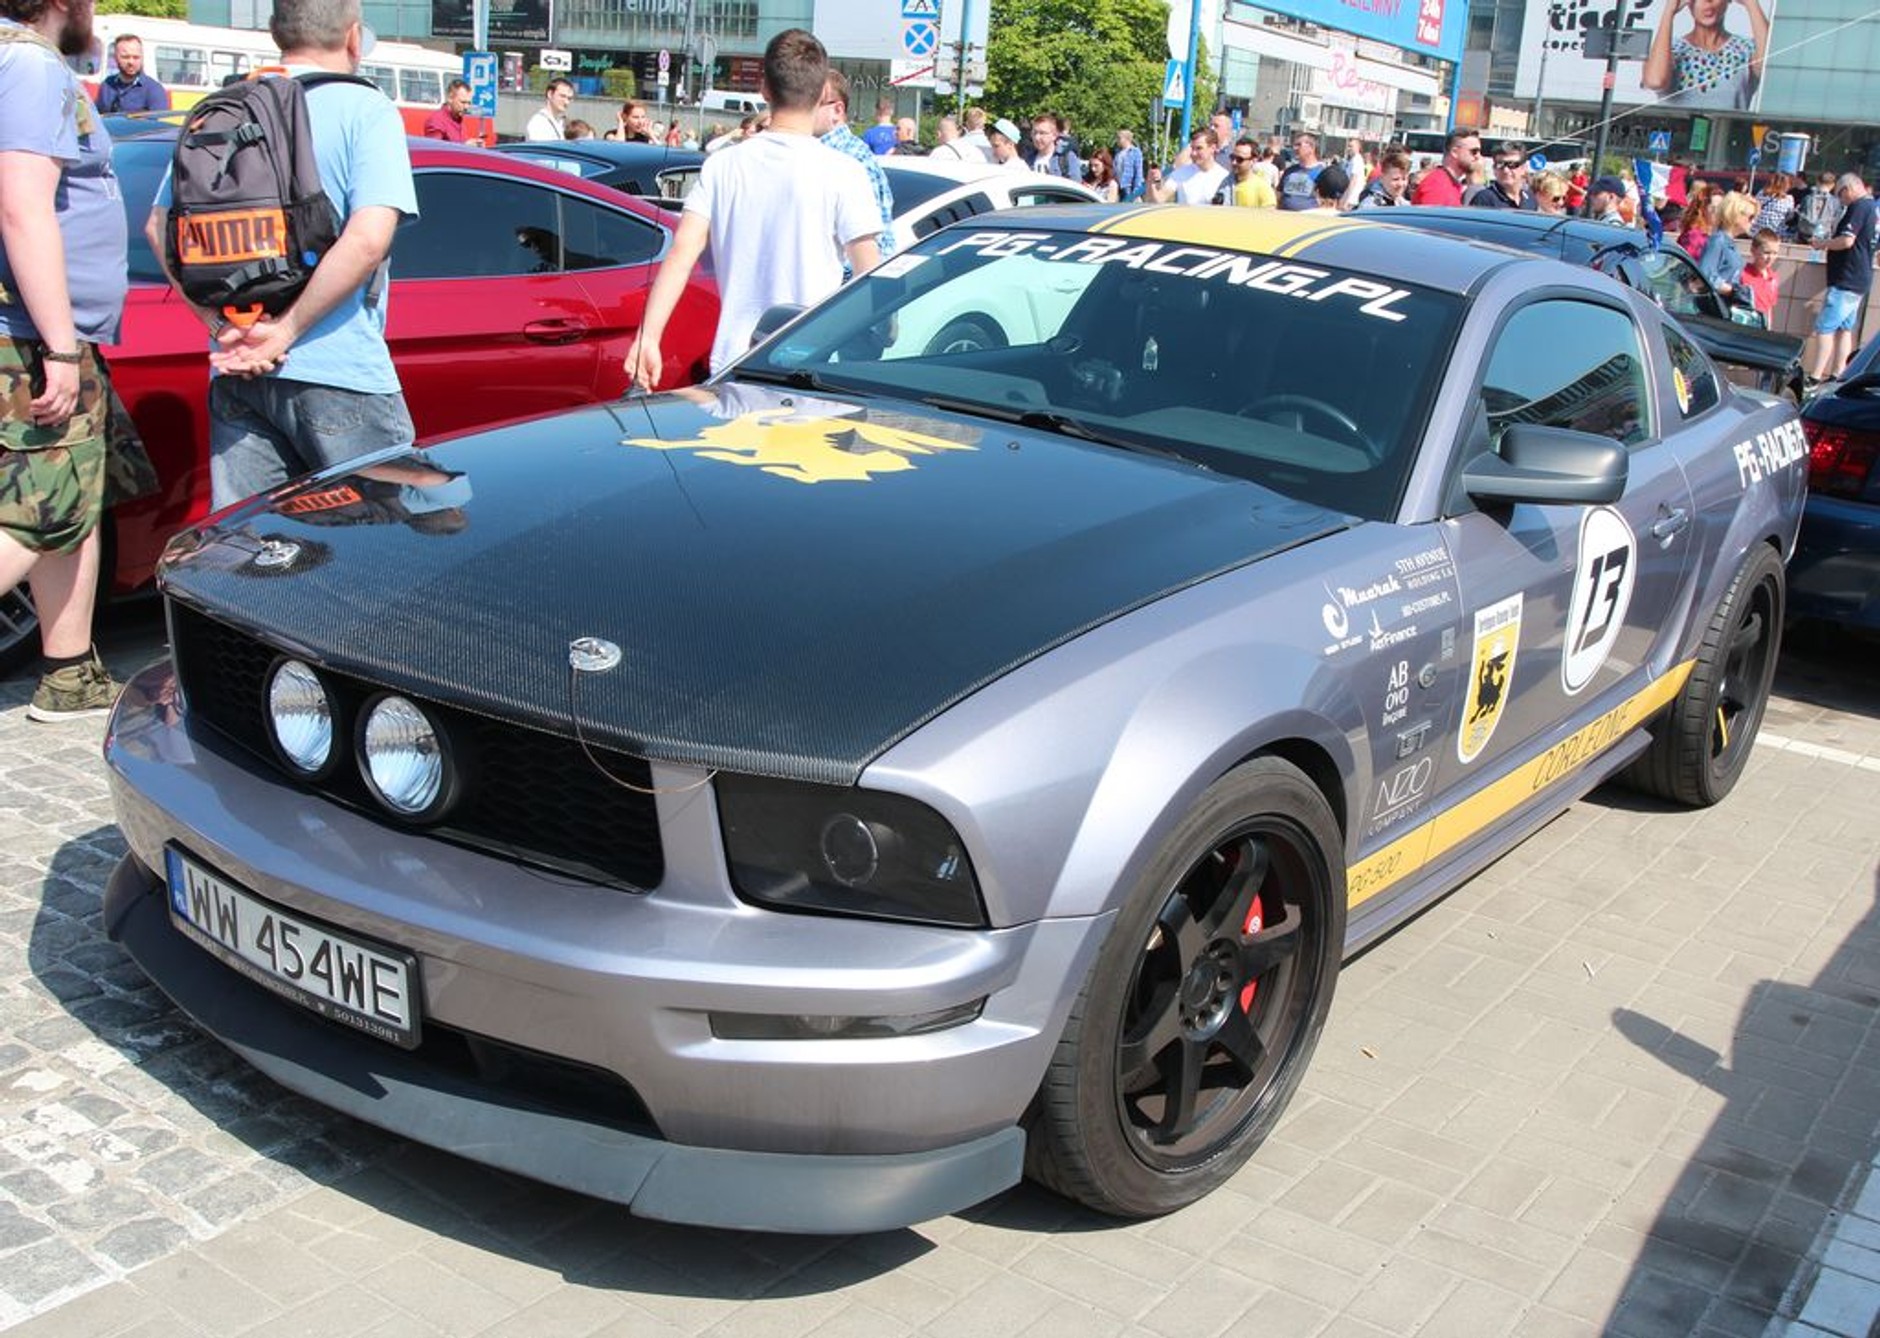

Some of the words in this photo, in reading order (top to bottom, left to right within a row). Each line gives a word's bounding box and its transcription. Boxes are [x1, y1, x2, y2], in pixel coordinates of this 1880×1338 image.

[183, 217, 275, 256] PUMA
[937, 233, 1411, 321] PG-RACING.PL
[1571, 545, 1628, 657] 13
[1388, 660, 1408, 691] AB
[188, 867, 239, 950] WW
[256, 914, 402, 1024] 454WE
